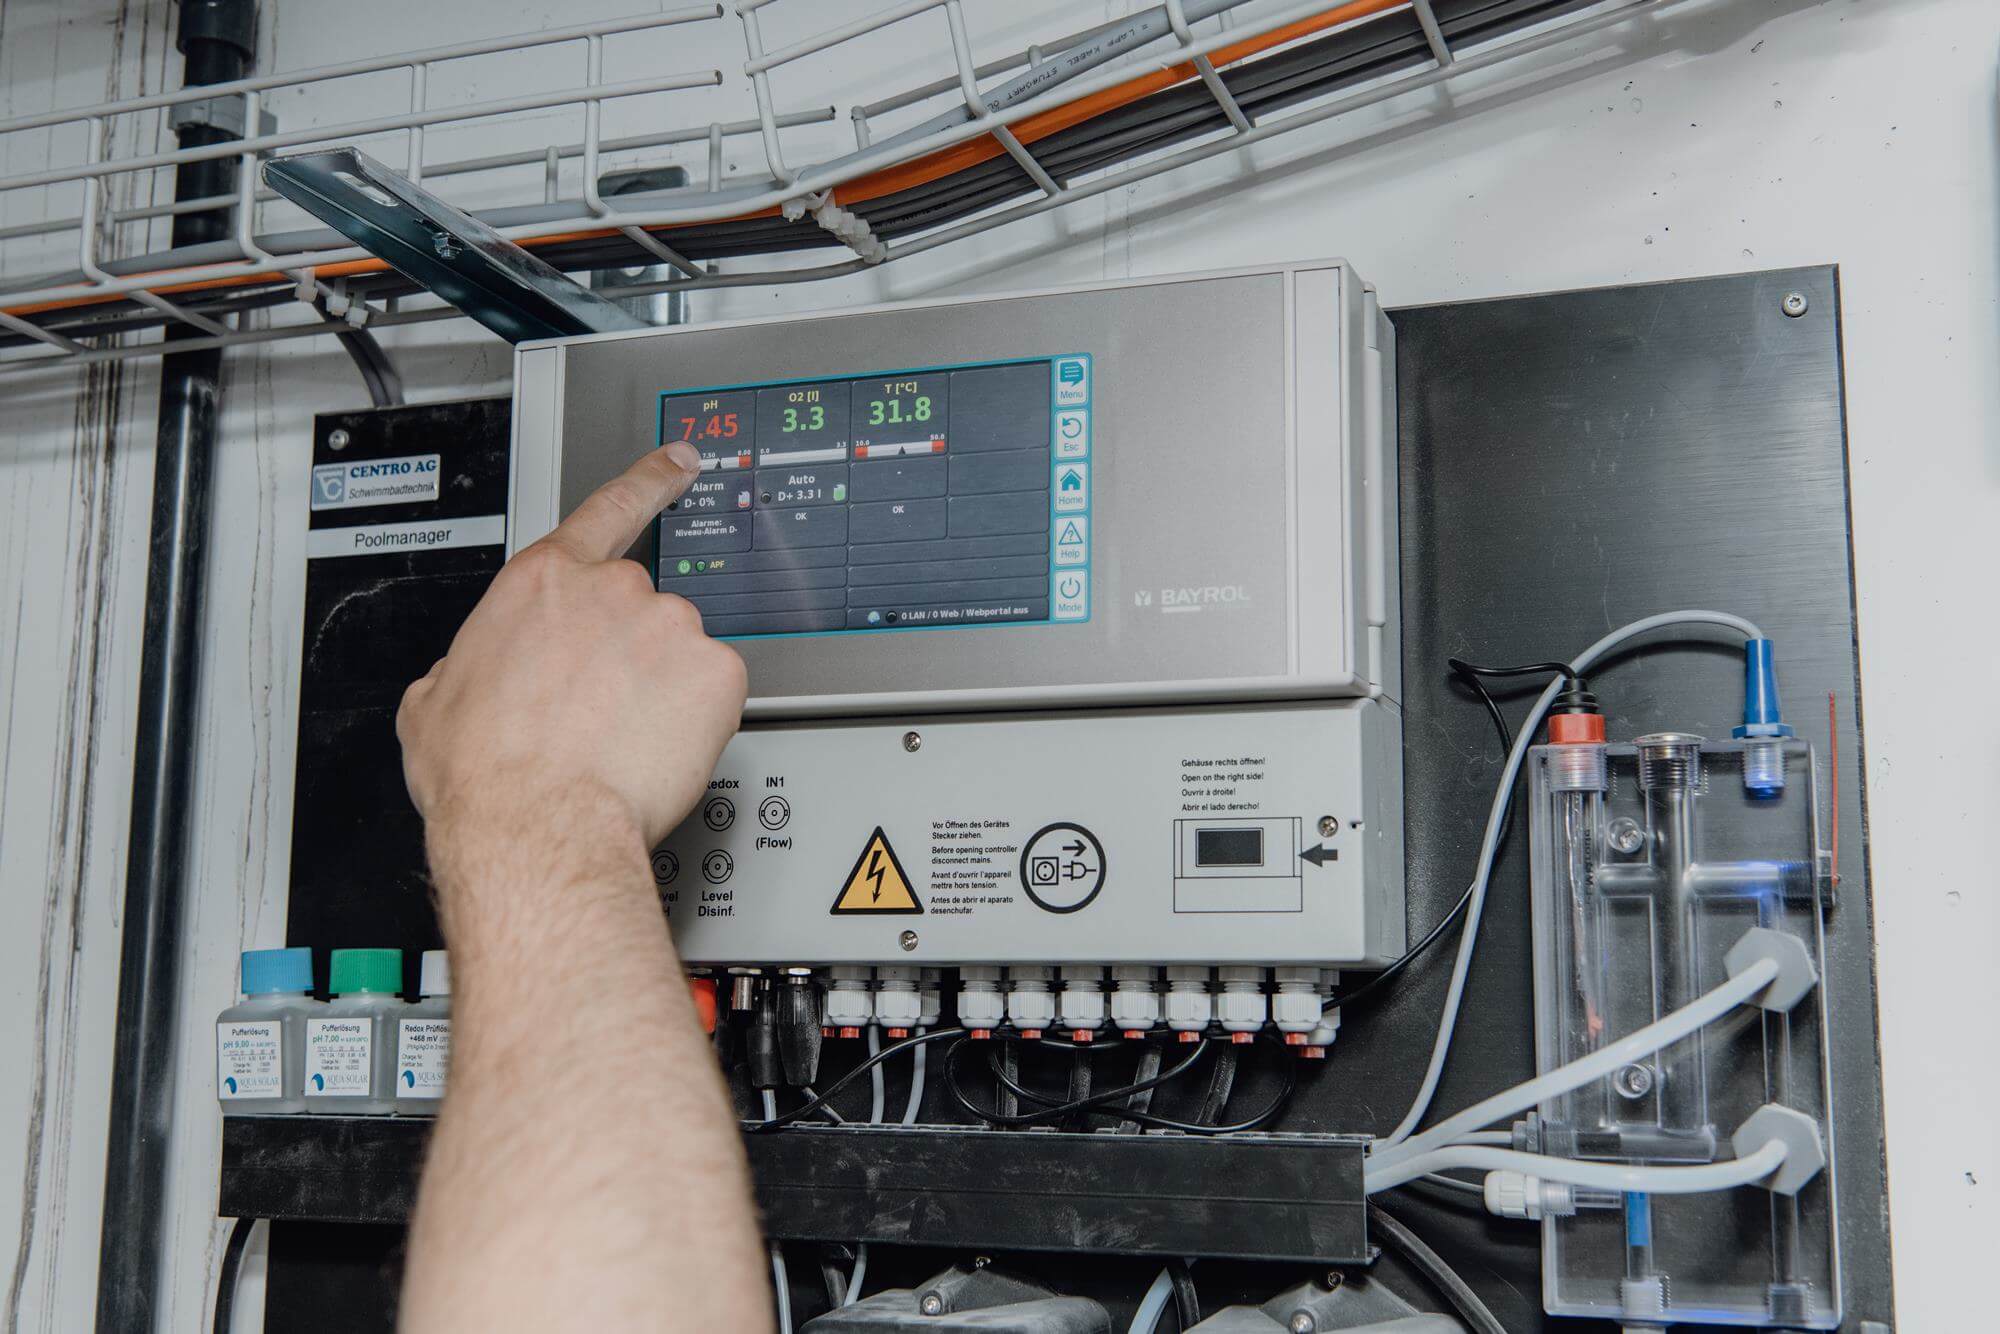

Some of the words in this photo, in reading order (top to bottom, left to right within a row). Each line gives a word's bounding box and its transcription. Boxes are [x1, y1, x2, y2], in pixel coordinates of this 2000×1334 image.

[884, 384, 892, 393] T
[896, 382, 917, 394] [°C]
[788, 392, 803, 403] O2
[1060, 390, 1083, 400] Menu
[703, 400, 718, 413] pH
[869, 396, 931, 426] 31.8
[782, 406, 824, 433] 3.3
[680, 413, 738, 441] 7.45
[855, 439, 870, 447] 10.0
[1063, 442, 1079, 452] Esc
[350, 462, 411, 479] CENTRO
[414, 459, 437, 473] AG
[788, 474, 815, 485] Auto
[348, 481, 436, 500] Schwimmbadtechnik
[691, 482, 724, 493] Alarm
[777, 491, 794, 502] D+
[797, 489, 814, 500] 3.3
[1058, 496, 1083, 505] Home
[684, 498, 696, 508] D-
[699, 496, 715, 507] 0%
[892, 505, 904, 514] OK
[795, 512, 807, 521] OK
[691, 519, 722, 528] Alarme:
[675, 527, 727, 537] Niveau-Alarm
[729, 526, 738, 535] D-
[354, 529, 452, 548] Poolmanager
[1060, 549, 1080, 560] Help
[710, 561, 725, 569] APF
[1161, 586, 1251, 605] BAYROL
[909, 612, 925, 620] LAN
[940, 610, 959, 619] Web
[966, 607, 1011, 618] Webportal
[1013, 607, 1029, 615] aus
[1058, 604, 1082, 613] Mode
[1181, 759, 1213, 768] Gehäuse
[1215, 758, 1238, 767] rechts
[1239, 757, 1266, 766] öffnen!
[766, 776, 785, 788] IN1
[1181, 774, 1201, 783] Open
[1213, 773, 1226, 781] the
[1227, 773, 1245, 782] right
[1246, 772, 1264, 780] side!
[1181, 788, 1204, 797] Ouvrir
[1212, 788, 1236, 796] droite!
[1181, 803, 1200, 812] Abrir
[1201, 803, 1208, 811] el
[1210, 803, 1226, 811] lado
[1227, 802, 1260, 810] derecho!
[932, 821, 944, 829] Vor
[945, 820, 968, 829] Öffnen
[969, 820, 982, 828] des
[983, 820, 1010, 828] Gerätes
[932, 831, 958, 840] Stecker
[958, 831, 982, 839] ziehen.
[755, 836, 793, 851] (Flow)
[931, 846, 954, 854] Before
[955, 846, 983, 855] opening
[984, 844, 1018, 853] controller
[931, 856, 968, 864] disconnect
[970, 856, 992, 864] mains.
[931, 871, 952, 880] Avant
[954, 881, 970, 889] hors
[971, 881, 998, 889] tension.
[659, 890, 679, 902] vel
[701, 890, 733, 902] Level
[930, 896, 952, 904] Antes
[953, 896, 962, 904] de
[962, 895, 978, 904] abrir
[980, 895, 987, 903] el
[987, 896, 1014, 905] aparato
[698, 904, 735, 918] Disinf.
[930, 906, 974, 915] desenchufar.
[404, 1024, 424, 1033] Redox
[312, 1035, 323, 1044] pH
